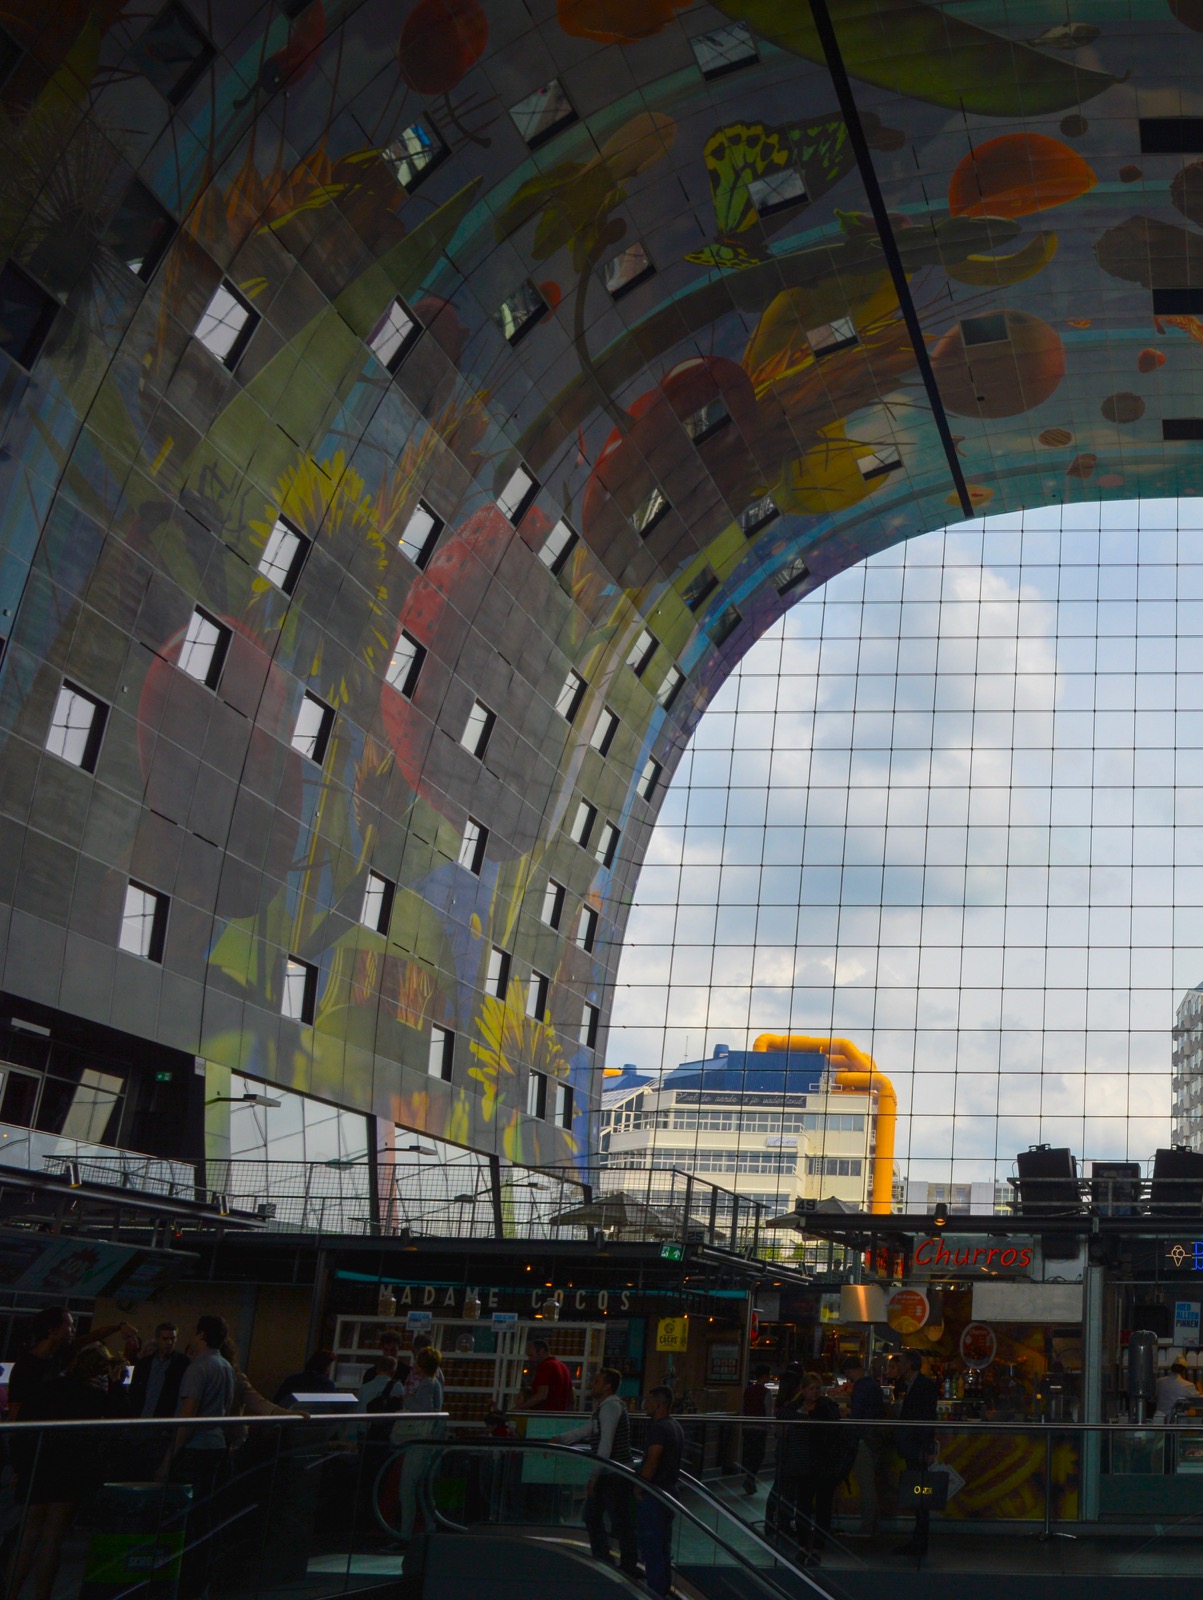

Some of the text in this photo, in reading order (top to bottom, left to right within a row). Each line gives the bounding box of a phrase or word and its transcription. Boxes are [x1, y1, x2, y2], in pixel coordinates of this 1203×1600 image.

[797, 1200, 816, 1210] 49
[687, 1231, 703, 1241] 25
[915, 1239, 1032, 1267] Churros
[531, 1289, 631, 1311] COCOS
